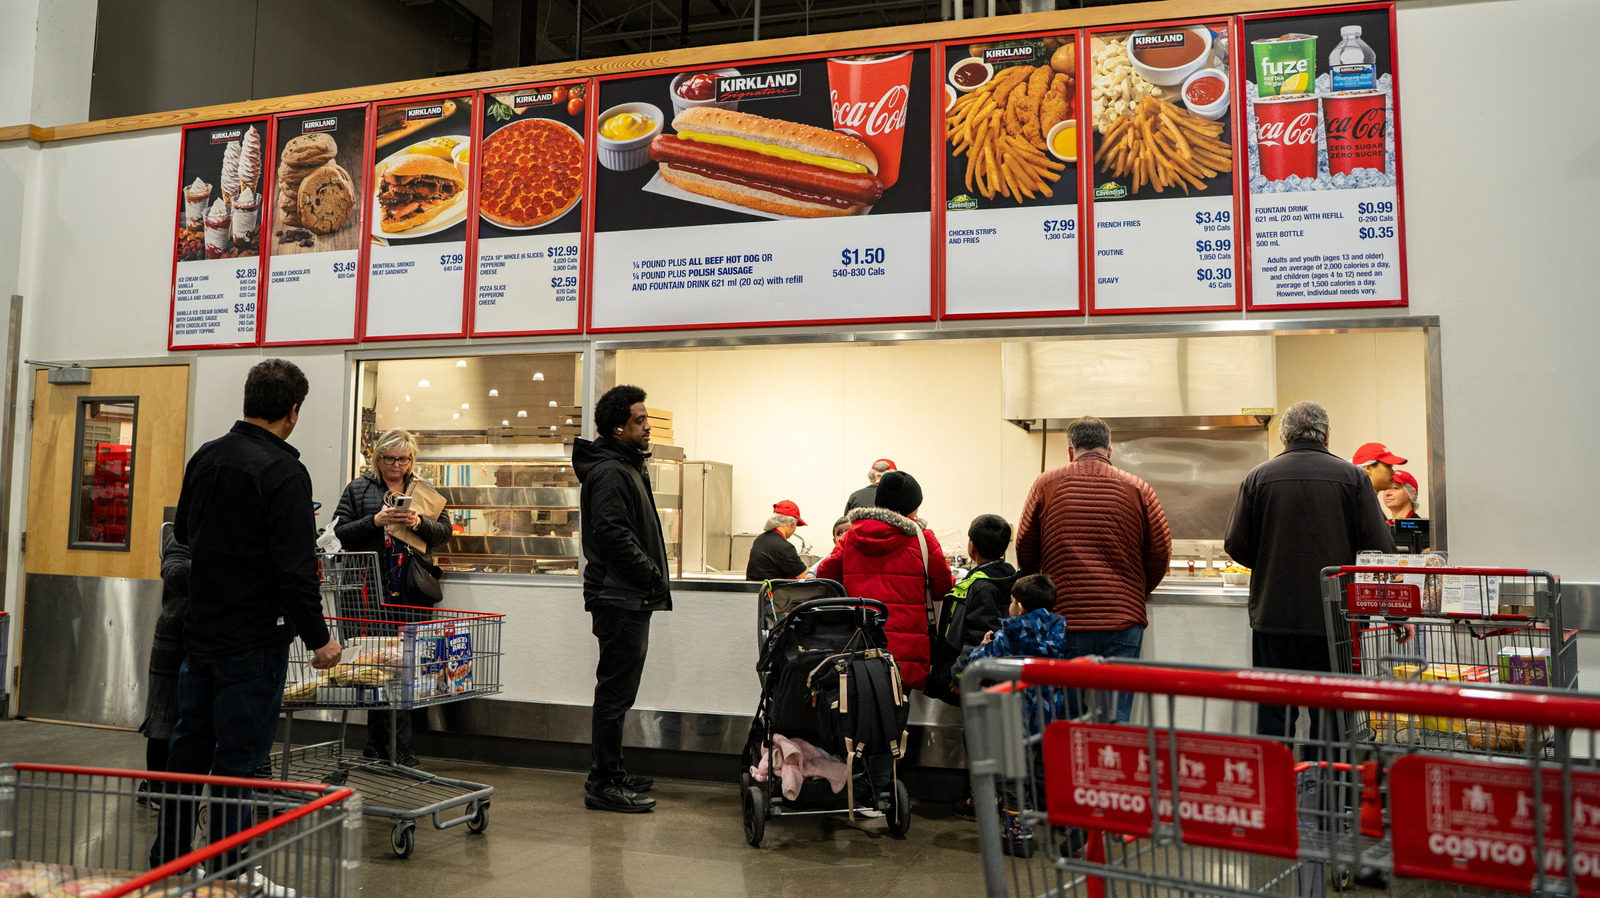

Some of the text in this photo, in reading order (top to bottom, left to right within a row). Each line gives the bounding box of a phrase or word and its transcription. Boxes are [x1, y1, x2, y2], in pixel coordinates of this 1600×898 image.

[1135, 34, 1183, 45] KIRKLAND
[986, 47, 1032, 58] KIRKLAND
[1261, 57, 1308, 76] fuze
[720, 73, 798, 92] KIRKLAND
[516, 93, 552, 103] KIRKLAND
[720, 87, 798, 101] Signature
[408, 106, 442, 117] KIRKLAND
[304, 119, 335, 129] KIRKLAND
[212, 131, 241, 139] KIRKLAND
[1330, 151, 1353, 159] ZÉRO
[1095, 187, 1125, 197] Cavendish
[948, 201, 976, 209] Cavendish
[1288, 205, 1308, 213] DRINK
[1358, 201, 1393, 215] $0.99
[1195, 210, 1230, 225] $3.49
[1281, 215, 1291, 223] (20
[1292, 214, 1302, 222] oz)
[1043, 219, 1075, 233] $7.99
[1256, 230, 1304, 239] WATER BOTTLE
[1359, 226, 1394, 240] $0.35
[547, 245, 578, 258] $12.99
[1196, 239, 1231, 254] $6.99
[440, 254, 463, 266] $7.99
[641, 259, 667, 268] POUND
[668, 258, 687, 267] PLUS
[688, 257, 703, 266] ALL
[705, 256, 724, 265] BEEF
[726, 255, 741, 264] HOT
[743, 254, 760, 263] DOG
[761, 253, 773, 262] OR
[841, 247, 885, 267] $1.50
[1303, 255, 1321, 264] youth
[1323, 255, 1341, 263] (ages
[1365, 252, 1384, 261] older)
[236, 268, 257, 279] $2.89
[333, 262, 356, 273] $3.49
[641, 270, 667, 279] POUND
[668, 269, 687, 278] PLUS
[688, 267, 716, 277] POLISH
[717, 266, 753, 276] SAUSAGE
[832, 266, 885, 278] 540-830 Cals
[1197, 267, 1232, 282] $0.30
[1283, 272, 1310, 280] children
[1311, 272, 1329, 280] (ages
[1345, 270, 1355, 278] 12)
[551, 276, 577, 288] $2.59
[632, 274, 803, 292] AND FOUNTAIN DRINK 621 ml (20 oz) with refill
[1276, 281, 1301, 290] average
[1311, 280, 1329, 288] 1,500
[1330, 279, 1356, 287] calories
[1363, 279, 1377, 287] day.
[1276, 290, 1306, 298] However,
[234, 303, 255, 313] $3.49
[1074, 787, 1146, 814] COSTCO
[1428, 833, 1527, 866] COSTCO
